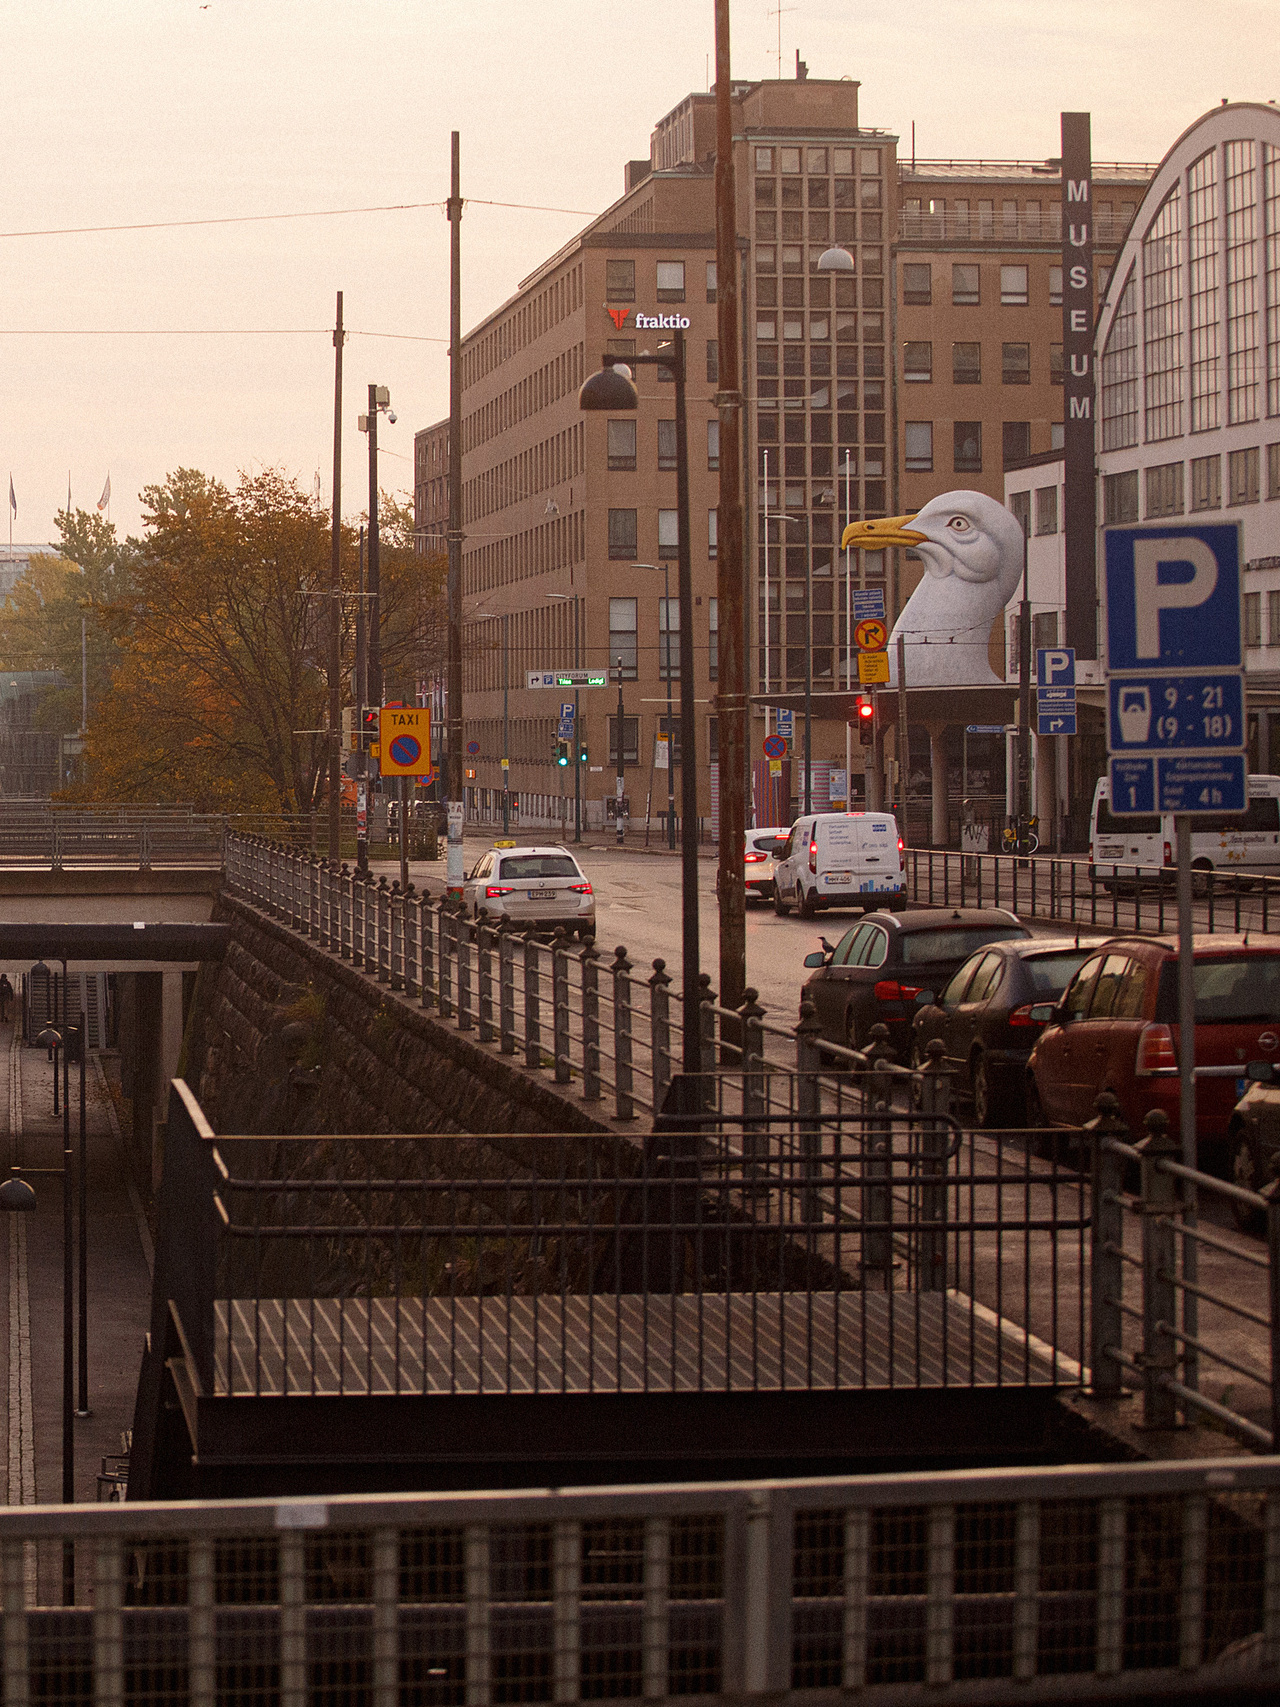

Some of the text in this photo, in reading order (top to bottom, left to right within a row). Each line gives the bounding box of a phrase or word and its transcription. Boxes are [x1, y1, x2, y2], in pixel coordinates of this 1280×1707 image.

[1067, 179, 1091, 419] MUSEUM
[635, 313, 691, 329] fraktio
[1134, 536, 1218, 660] P
[1045, 651, 1070, 685] P
[1164, 687, 1179, 708] 9
[1201, 685, 1223, 709] 21
[391, 714, 419, 726] TAXI
[562, 704, 573, 717] P
[779, 708, 789, 721] P
[1156, 716, 1179, 739] (9
[1202, 714, 1232, 738] 18)
[1127, 786, 1137, 808] 1
